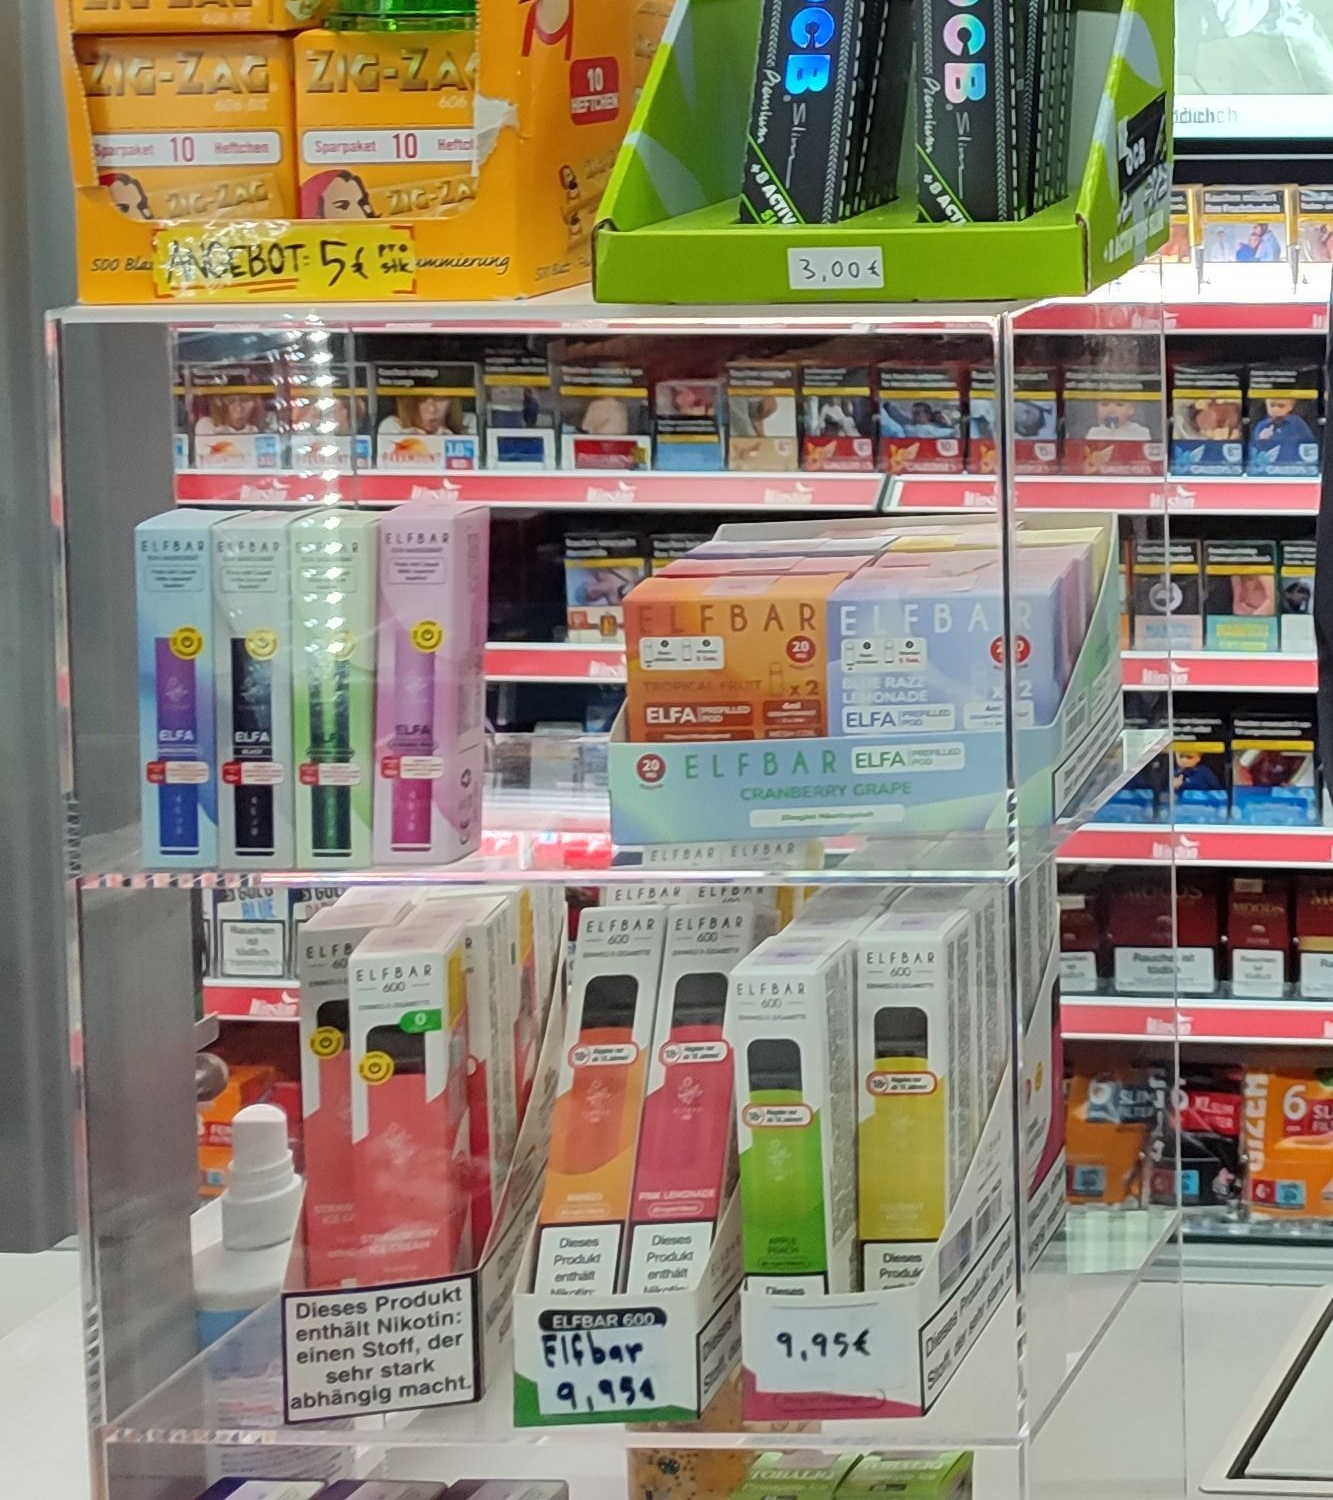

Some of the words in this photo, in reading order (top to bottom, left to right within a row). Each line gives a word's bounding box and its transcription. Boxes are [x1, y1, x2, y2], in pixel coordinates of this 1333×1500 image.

[85, 52, 271, 96] ZIG-ZAG
[587, 68, 604, 91] 10
[169, 137, 195, 162] 10
[214, 141, 269, 154] Heftchen
[315, 141, 376, 153] Sparpaket
[141, 541, 204, 552] ELFBAR
[386, 533, 449, 544] ELFBAR
[638, 605, 817, 633] ELFBAR
[646, 707, 696, 725] ELFA
[846, 711, 896, 728] ELFA
[159, 731, 193, 742] ELFA
[235, 732, 270, 743] ELFA
[642, 760, 661, 771] 20
[686, 751, 835, 779] ELFBAR
[855, 752, 906, 769] ELFA
[740, 784, 849, 800] CRANBERRY
[854, 781, 912, 796] GRAPE
[675, 917, 744, 931] ELFBAR
[866, 951, 935, 965] ELFBAR
[356, 965, 432, 981] ELFBAR
[737, 983, 807, 997] ELFBAR
[297, 1293, 366, 1319] Dieses
[375, 1286, 462, 1312] Produkt
[296, 1319, 371, 1341] enthält
[377, 1310, 462, 1334] Nikotin:
[552, 1314, 619, 1328] ELFBAR
[624, 1311, 656, 1326] 600
[297, 1343, 355, 1365] einen
[362, 1336, 421, 1359] Stoff,
[428, 1330, 463, 1352] der
[326, 1362, 374, 1384] sehr
[380, 1357, 434, 1377] stark
[290, 1386, 393, 1411] abhängig
[399, 1375, 472, 1399] macht.
